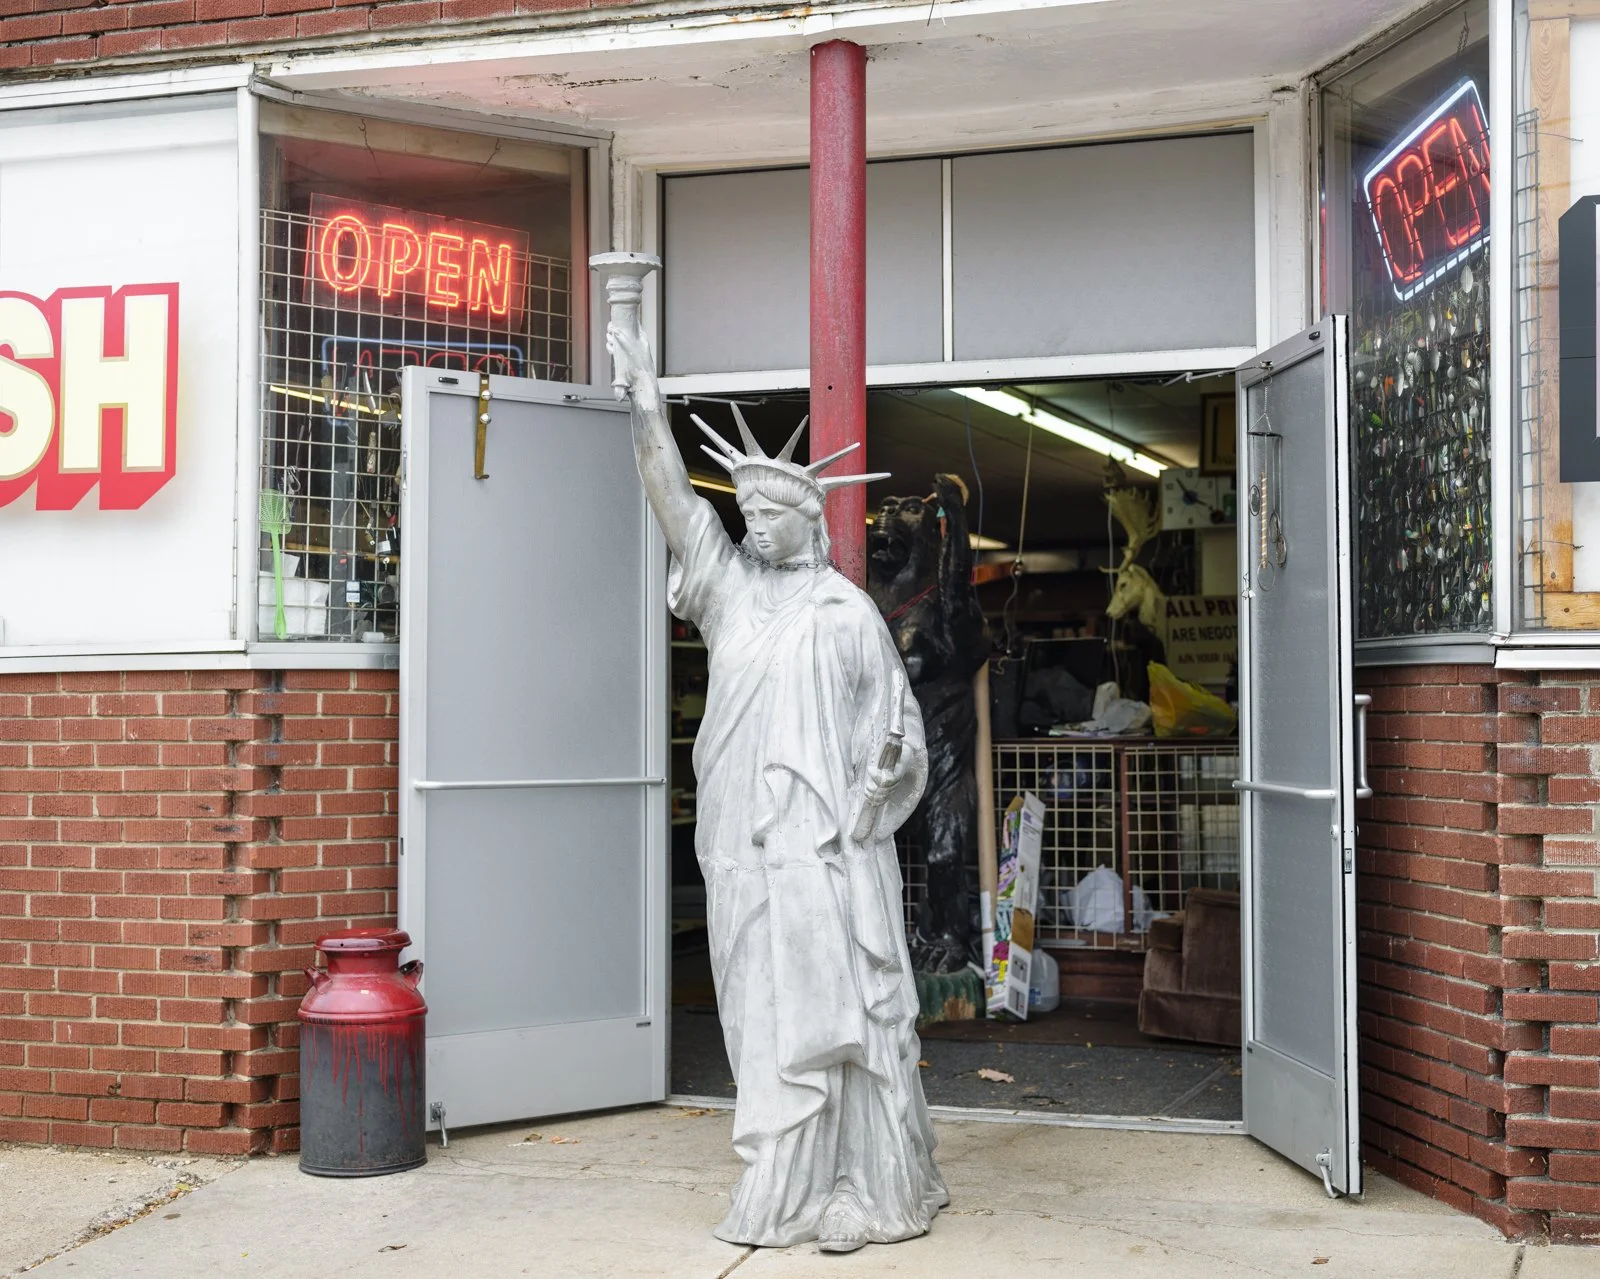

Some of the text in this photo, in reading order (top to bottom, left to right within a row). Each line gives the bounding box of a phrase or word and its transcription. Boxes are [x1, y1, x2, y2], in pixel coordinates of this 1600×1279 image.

[319, 214, 512, 316] OPEN
[1166, 600, 1201, 618] ALL
[1172, 626, 1197, 641] ARE
